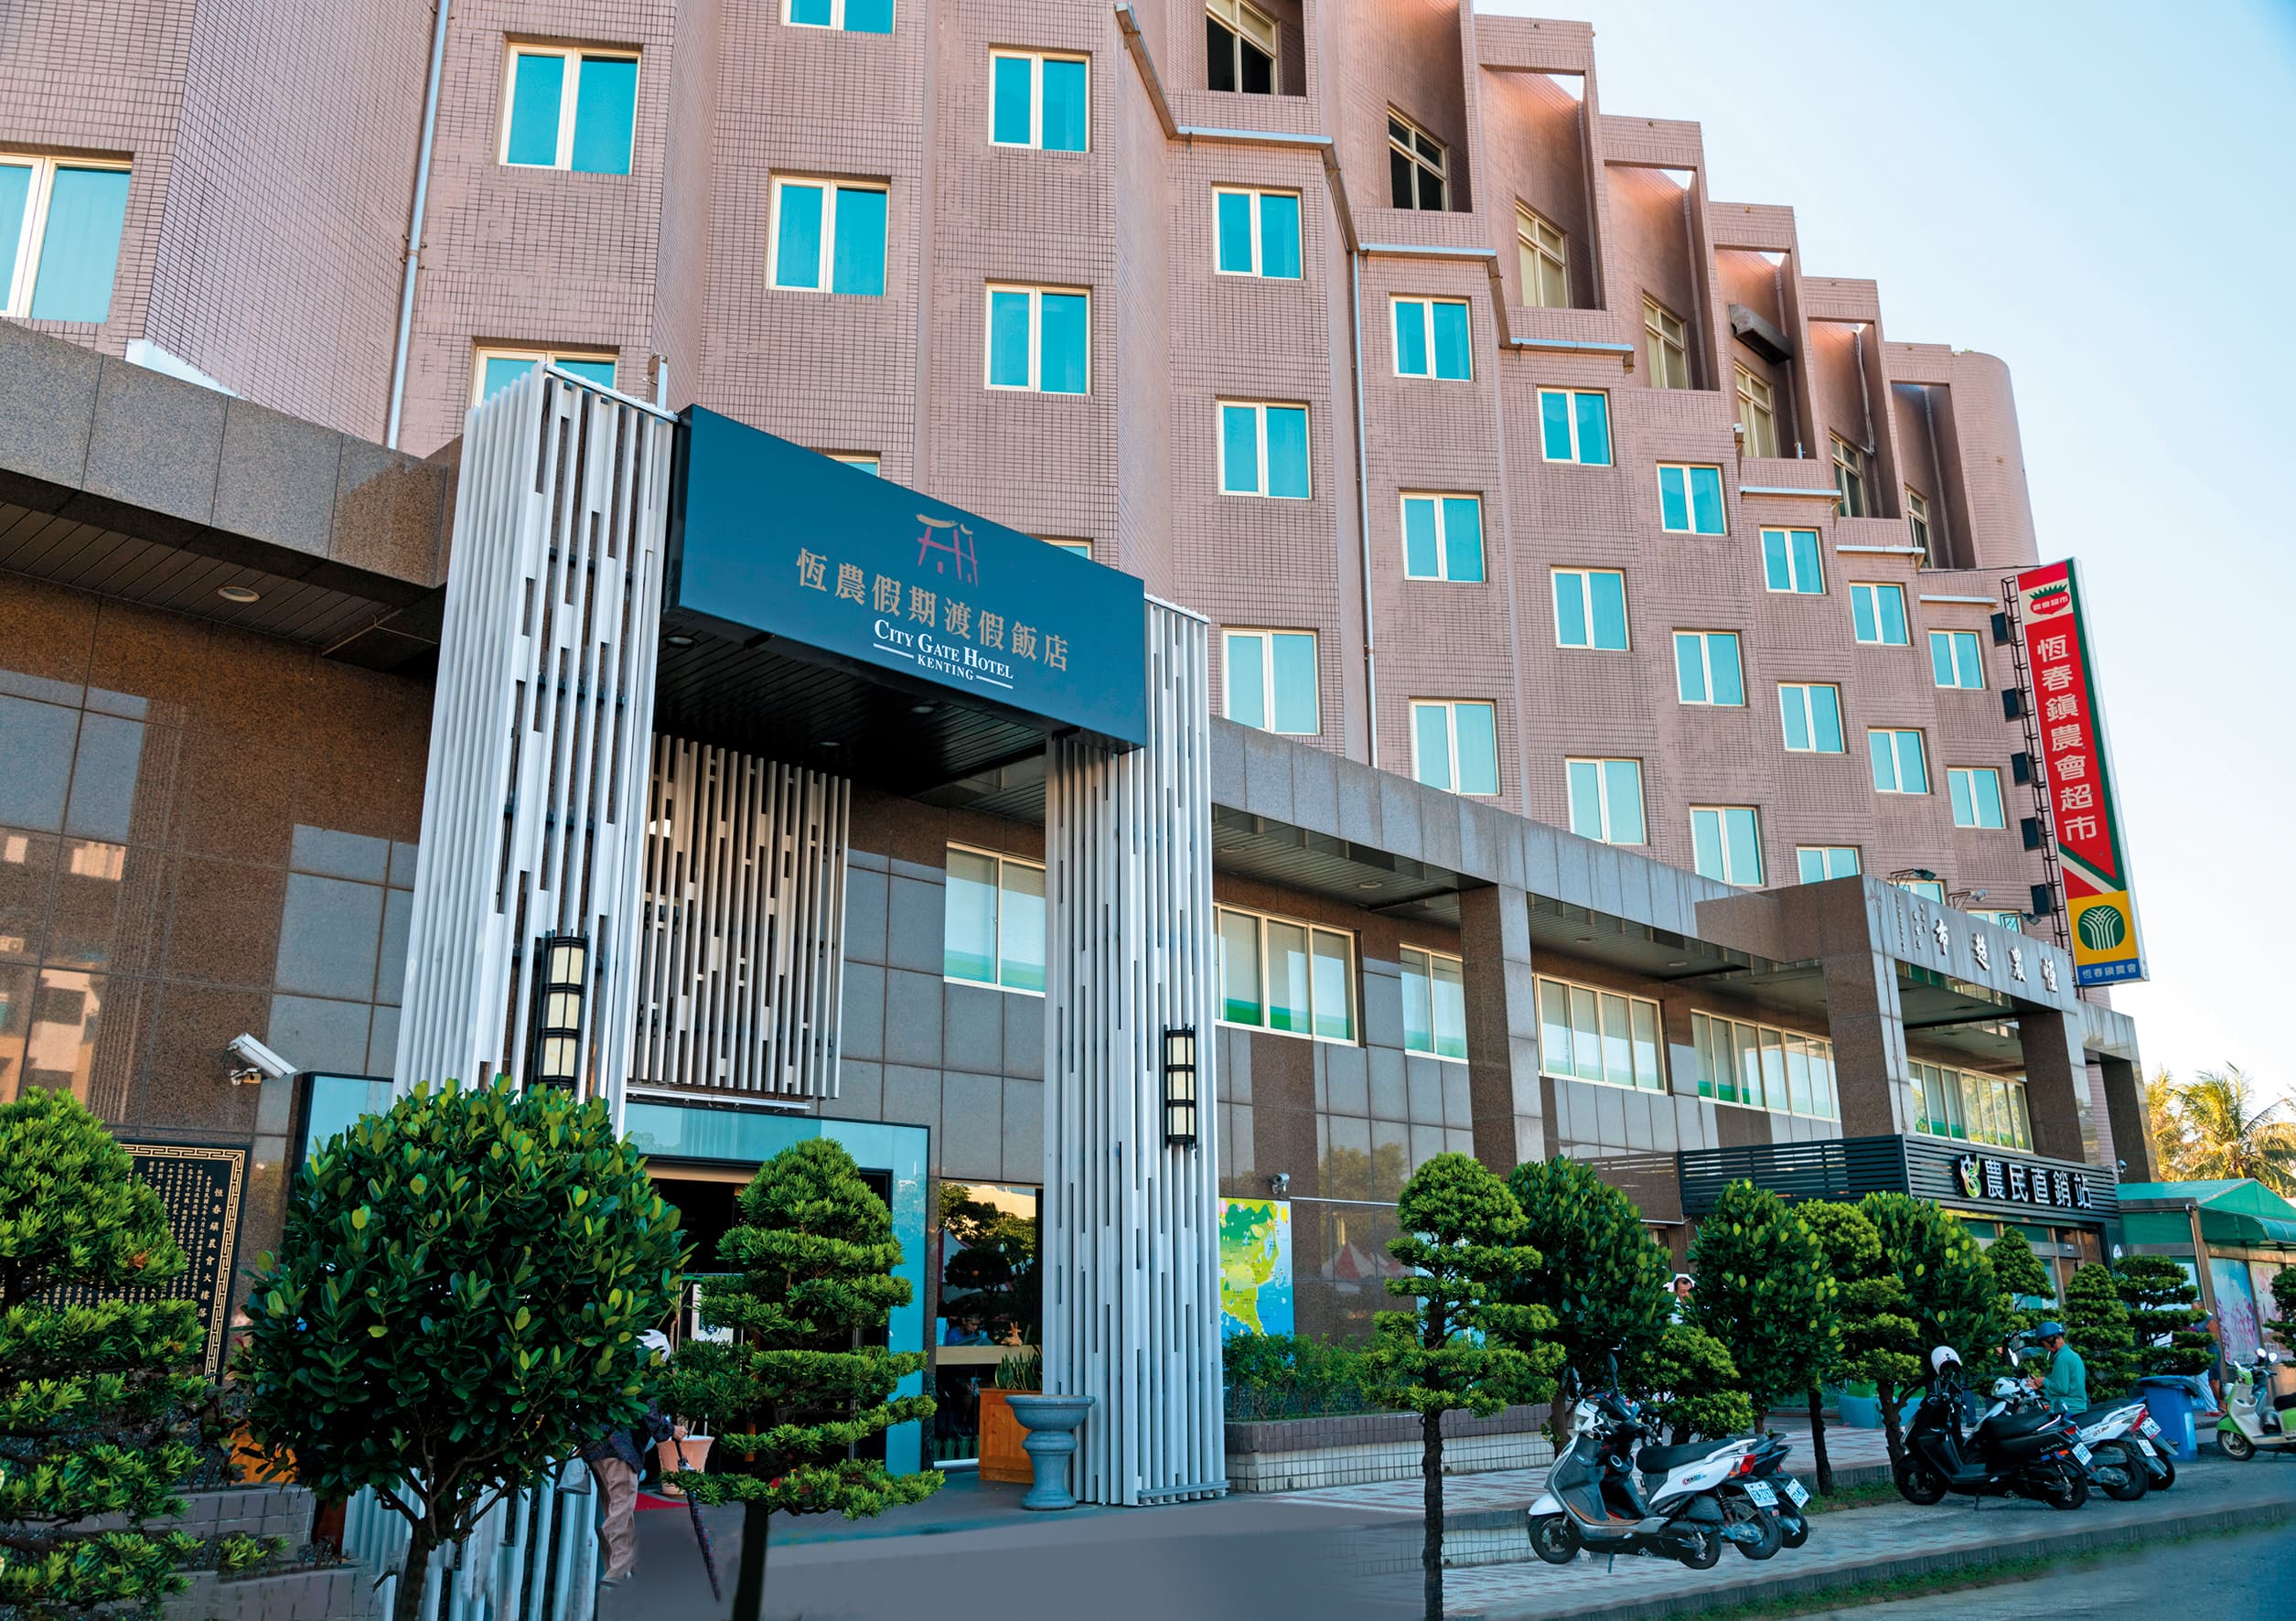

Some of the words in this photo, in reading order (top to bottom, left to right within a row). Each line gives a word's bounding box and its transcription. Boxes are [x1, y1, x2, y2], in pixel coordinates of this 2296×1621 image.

[794, 546, 1069, 672] 恆農假期渡假飯店
[917, 653, 974, 681] KENTING
[2036, 633, 2098, 843] 恆春鎮農會超市
[1985, 1160, 2093, 1210] 農民直銷站
